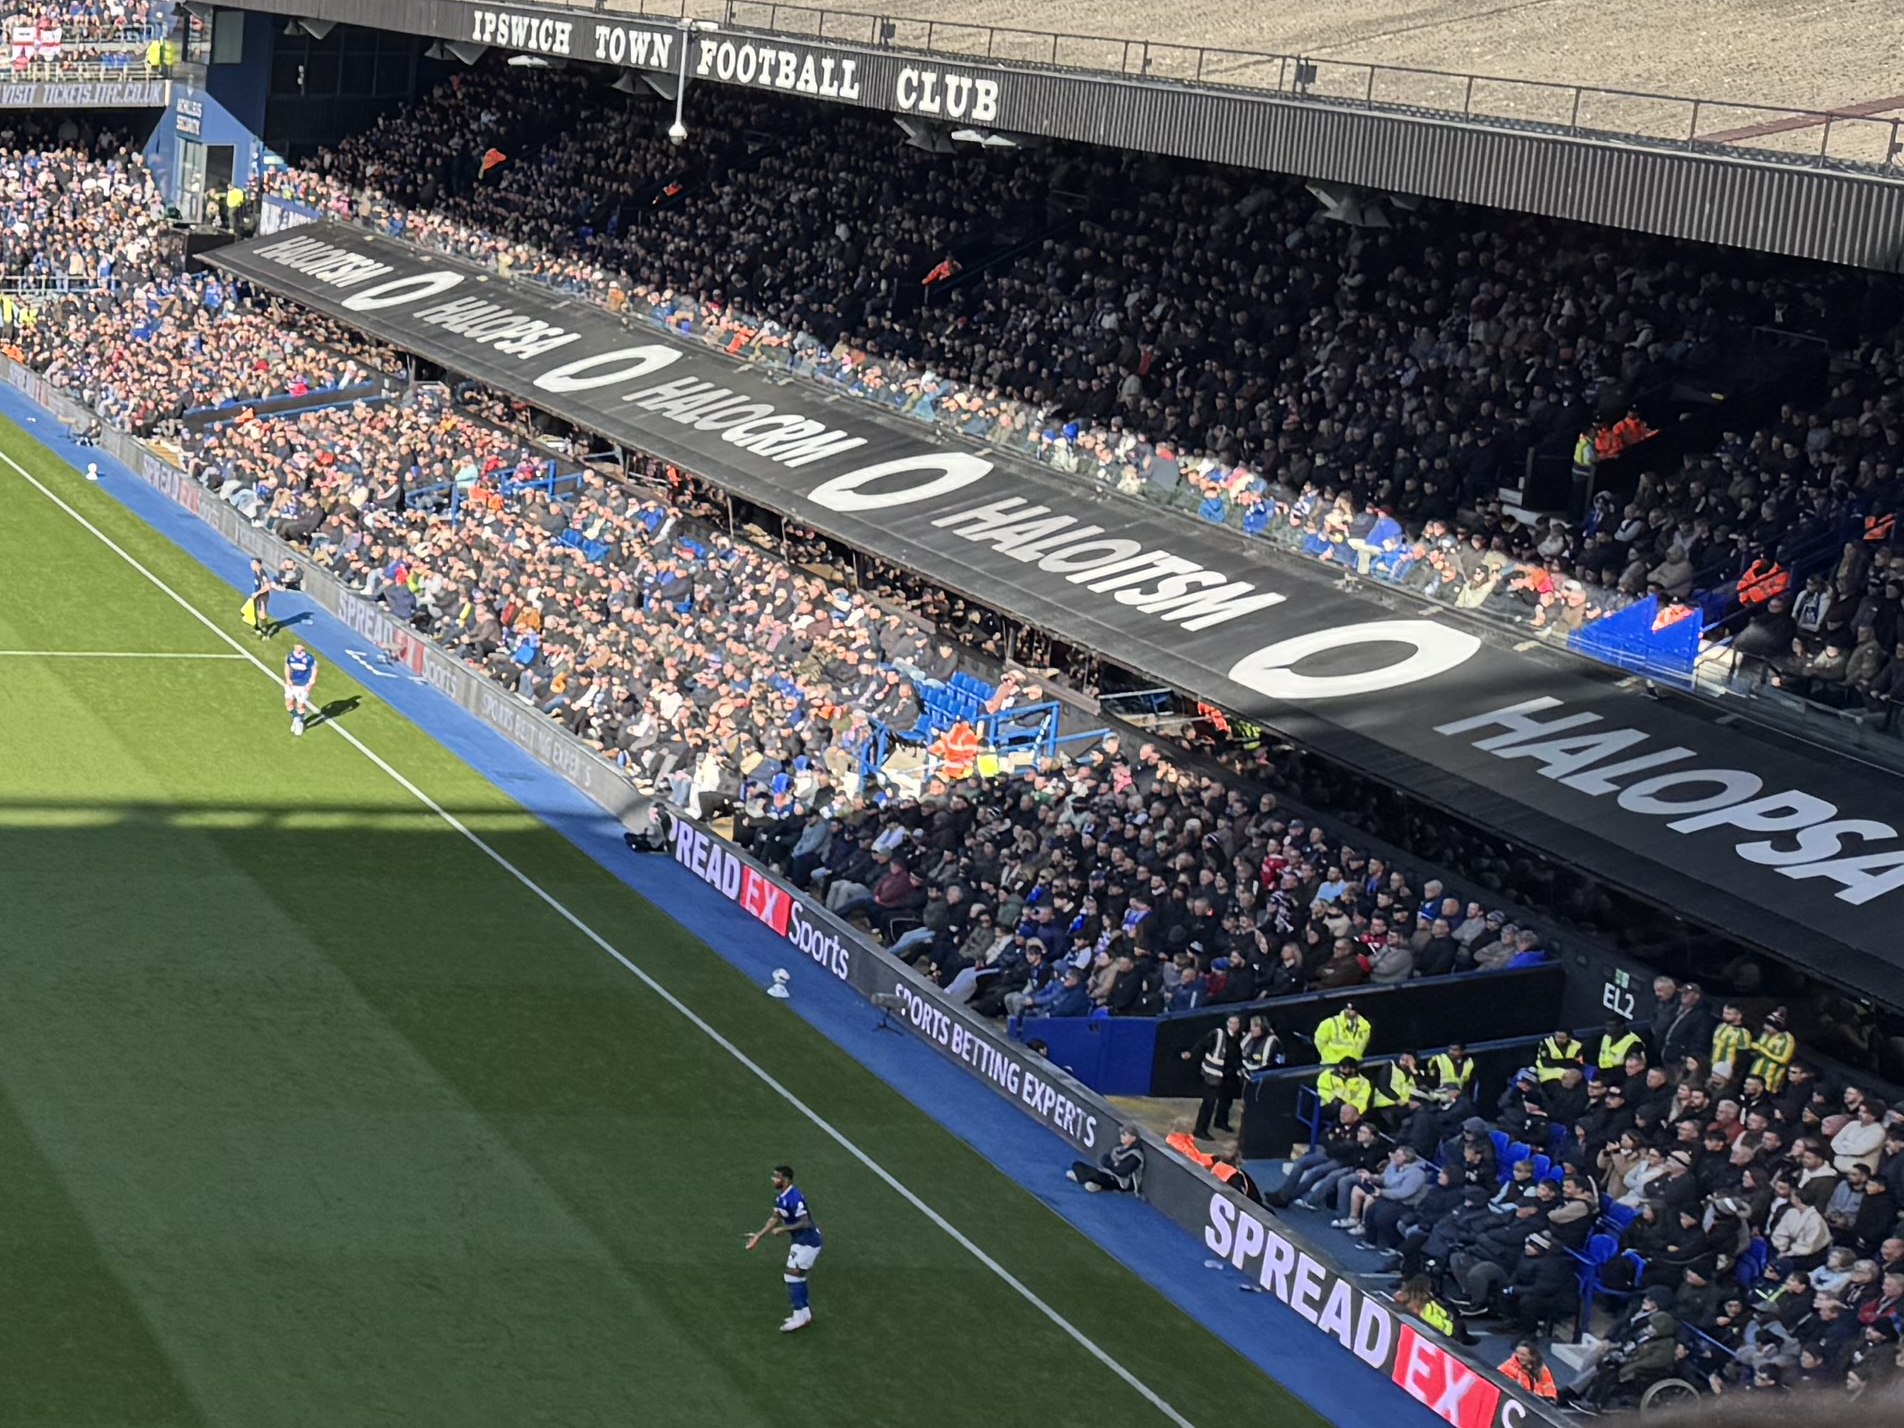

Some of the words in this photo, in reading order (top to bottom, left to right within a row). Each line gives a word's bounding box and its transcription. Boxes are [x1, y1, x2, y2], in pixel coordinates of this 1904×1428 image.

[2, 83, 37, 104] VISIT
[43, 83, 163, 104] TICKETS.ITFC.CO.UK
[471, 10, 573, 54] IPSWICH
[594, 26, 673, 69] TOWN
[696, 38, 861, 100] FOOTBALL
[896, 68, 1000, 122] CLUB
[252, 235, 394, 287] HALOITSM
[413, 296, 582, 360] HALOPSA
[622, 376, 867, 468] HALOCRM
[932, 496, 1288, 632] HALOITSM
[339, 591, 393, 647] SPREAD
[482, 693, 514, 731] SPORTS
[1433, 695, 1904, 906] HALOPSA
[745, 868, 781, 926] EX
[788, 901, 850, 981] Sports
[1602, 982, 1635, 1021] EL2
[951, 1023, 1022, 1095] BETTING
[1022, 1071, 1097, 1148] EXPERTS
[1204, 1193, 1392, 1369] SPREAD
[1404, 1332, 1477, 1428] EX
